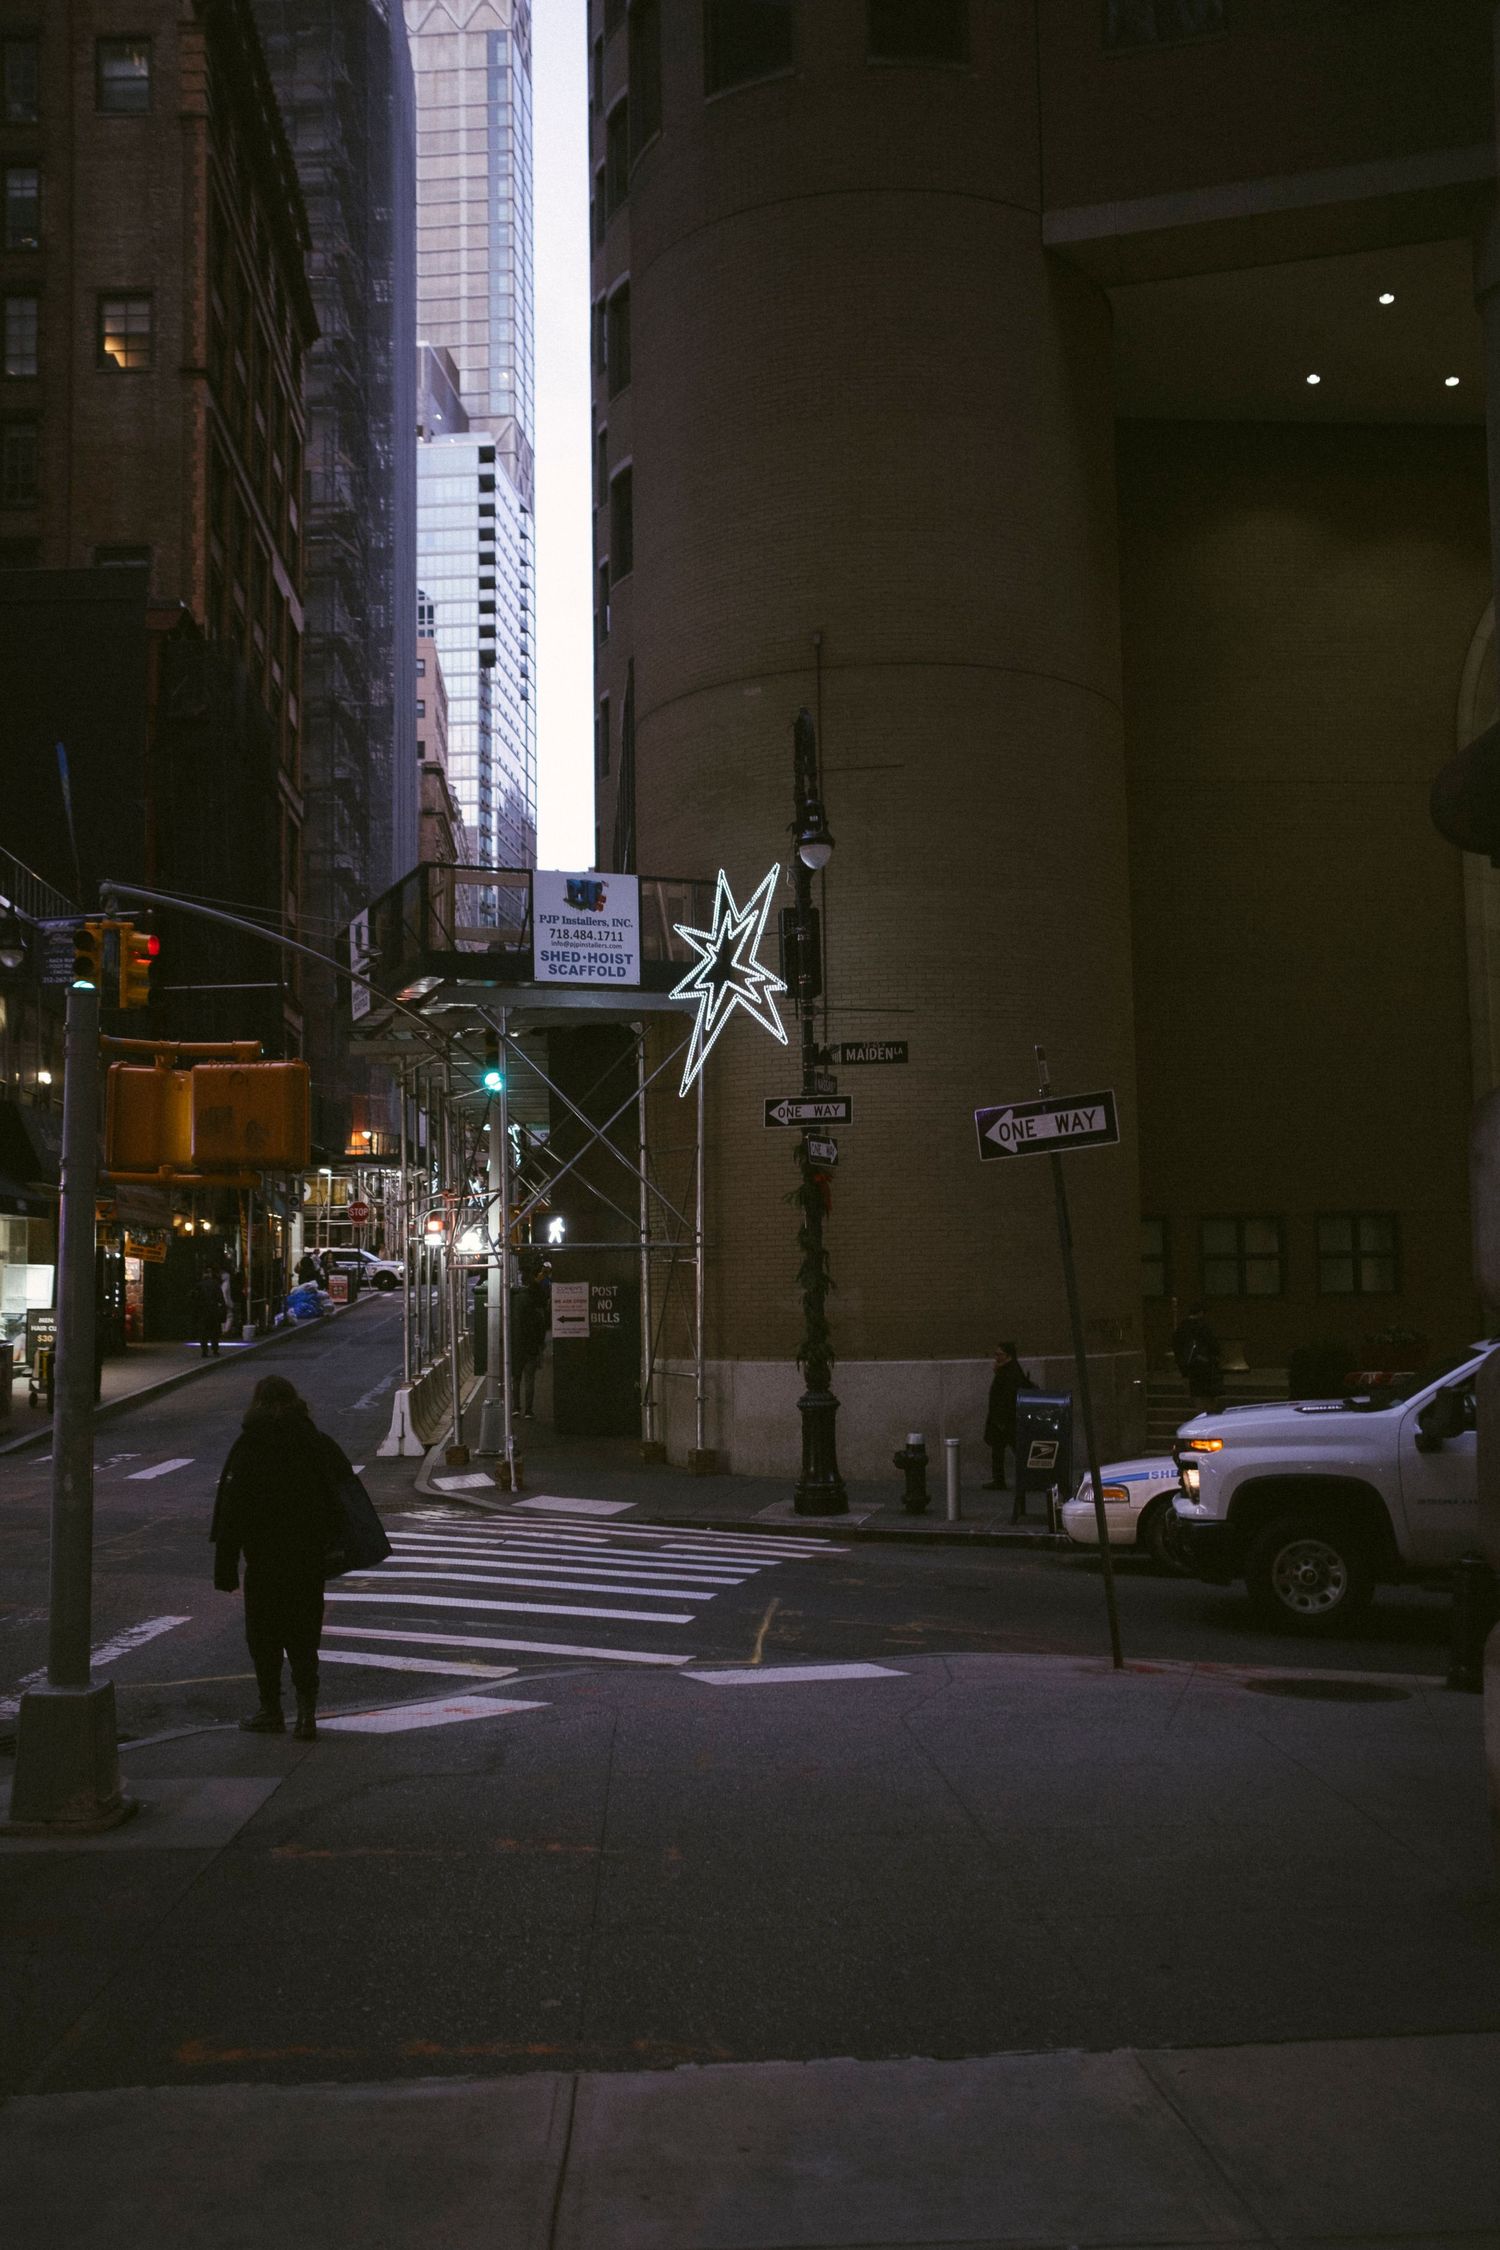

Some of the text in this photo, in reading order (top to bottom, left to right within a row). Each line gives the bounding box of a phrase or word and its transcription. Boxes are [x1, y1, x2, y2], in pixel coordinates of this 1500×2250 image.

[539, 914, 633, 928] PJP Installers, INC.
[550, 928, 624, 942] 718.484.1711
[551, 940, 622, 950] info@pjpinstallers.com
[548, 964, 626, 977] SCAFFOLD
[846, 1047, 903, 1061] MAIDEN LA
[778, 1104, 840, 1118] ONE WAY
[999, 1109, 1096, 1141] ONE WAY
[349, 1207, 368, 1216] STOP
[591, 1285, 618, 1297] POST
[597, 1299, 613, 1310] NO
[590, 1312, 620, 1323] BILLS
[37, 1334, 54, 1343] $30
